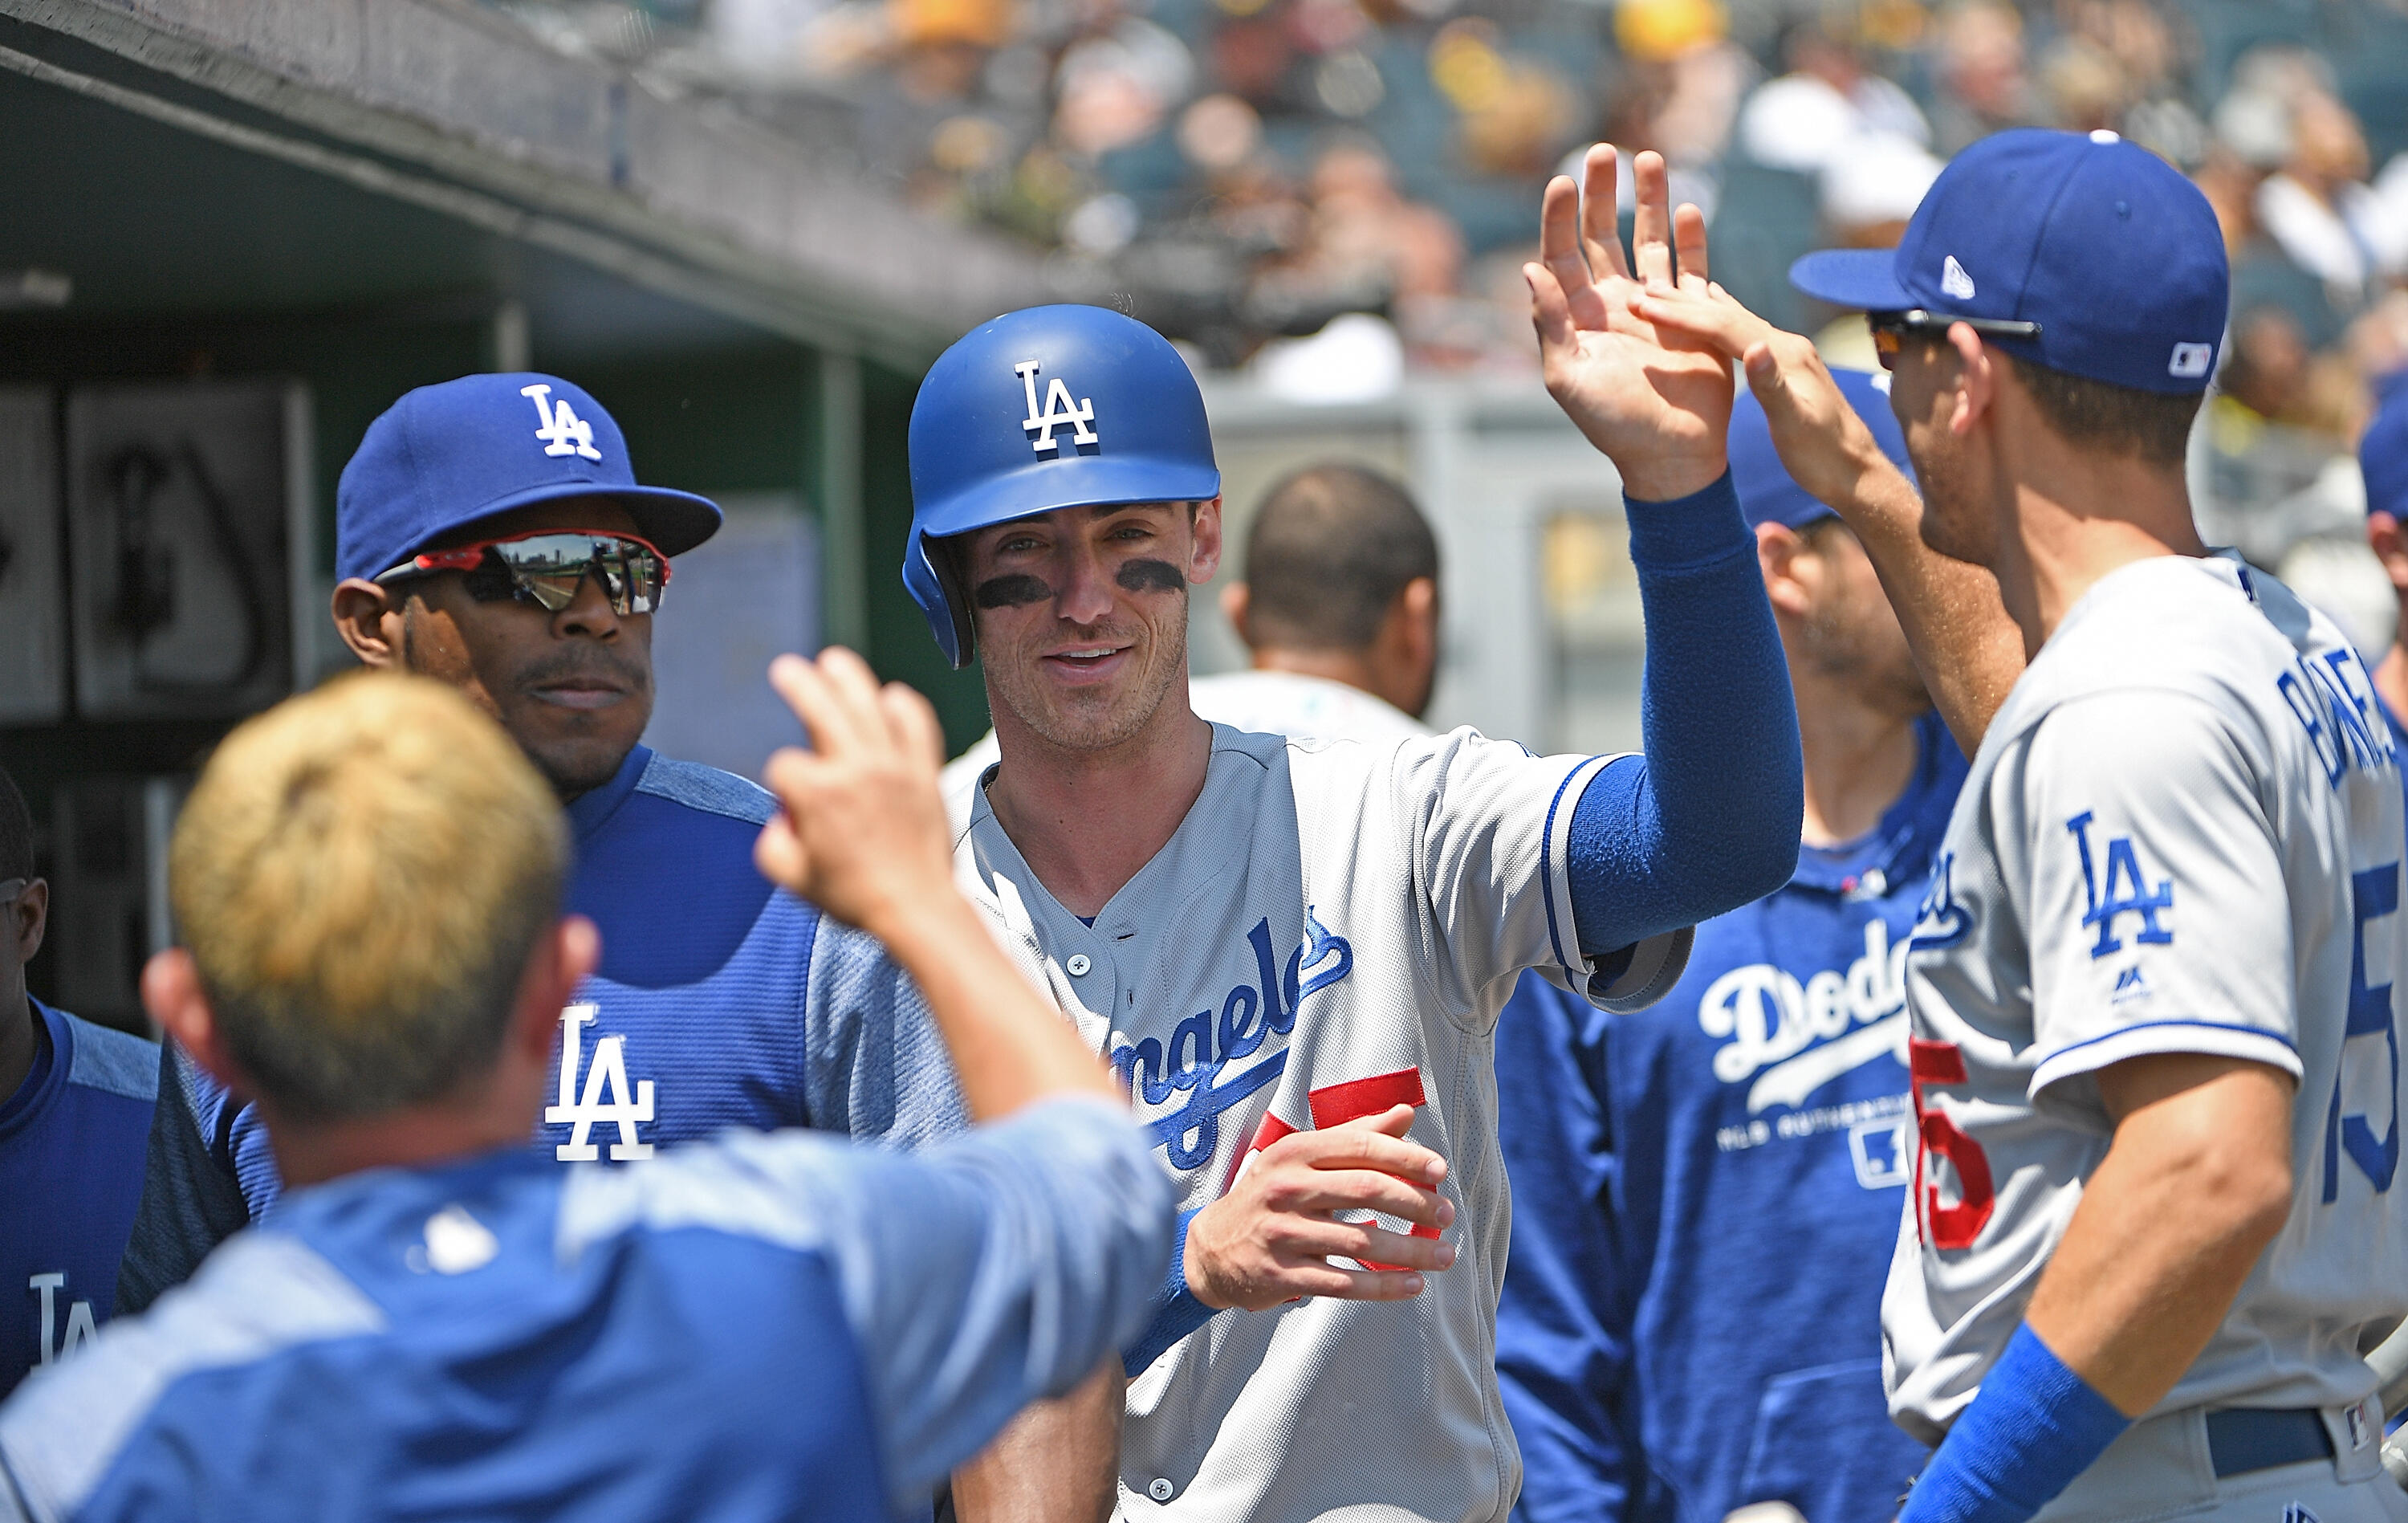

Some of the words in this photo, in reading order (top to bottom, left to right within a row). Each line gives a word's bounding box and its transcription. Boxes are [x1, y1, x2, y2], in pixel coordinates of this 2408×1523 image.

[520, 383, 602, 461] LA
[1014, 360, 1099, 451] LA
[2066, 810, 2173, 959] LA
[544, 1004, 657, 1162] LA
